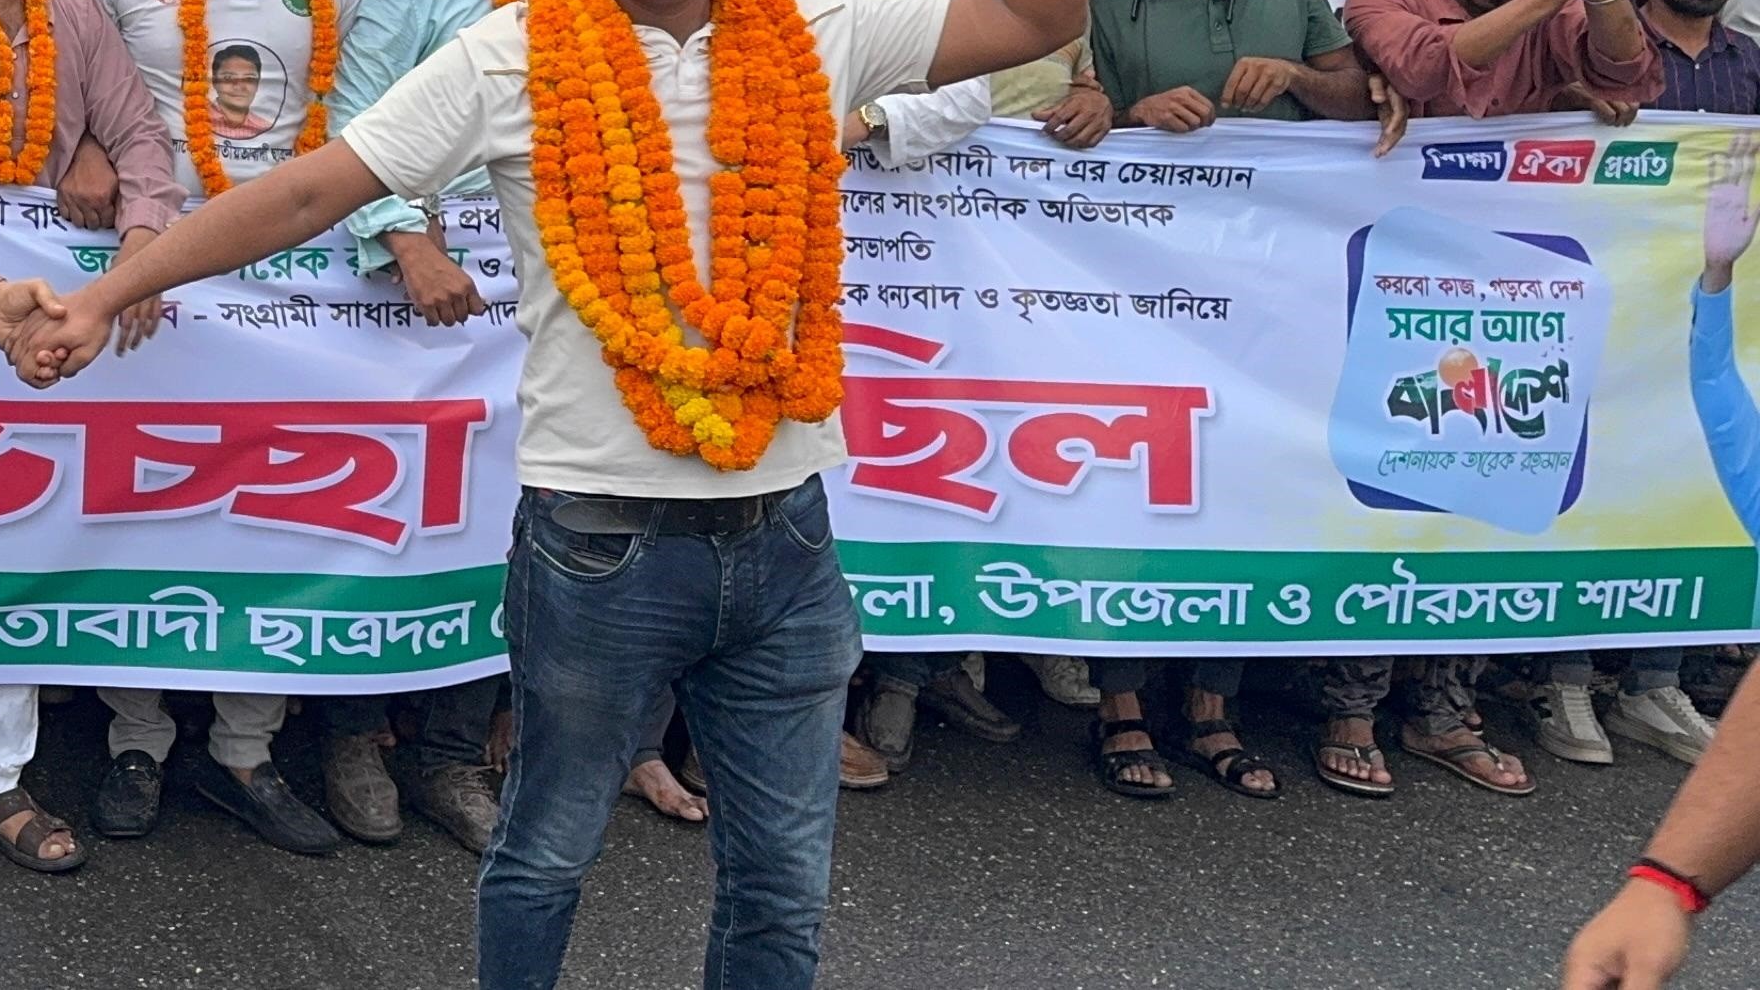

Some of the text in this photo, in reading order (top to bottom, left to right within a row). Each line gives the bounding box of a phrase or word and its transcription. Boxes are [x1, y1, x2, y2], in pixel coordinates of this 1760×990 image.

[1006, 155, 1056, 181] দল
[1063, 160, 1108, 185] এর
[1117, 160, 1258, 191] চেয়ারম্যান
[1426, 148, 1502, 173] শিক্ষা
[1517, 149, 1586, 179] ঐক্য
[1603, 149, 1669, 179] প্রগতি
[890, 184, 1029, 221] সাংগঠনিক
[1038, 193, 1177, 228] অভিভাবক
[239, 246, 329, 281] ারেক
[843, 231, 936, 262] সভাপতি
[877, 283, 1232, 324] ধন্যবাদ ও কৃতজ্ঞতা জানিয়ে
[1373, 274, 1430, 298] করবো
[1490, 278, 1545, 303] গড়বো
[1549, 278, 1585, 301] দেশ
[217, 295, 320, 329] সংগ্রামী
[1385, 307, 1566, 346] সবার আগে
[839, 322, 1208, 514] ছিল
[1378, 450, 1572, 477] দেশনায়ক তারেক রহমান
[245, 599, 476, 665] ছাত্রদল
[842, 572, 956, 626] লা,
[975, 562, 1254, 627] উপজেলা
[1267, 583, 1312, 626] ও
[1335, 557, 1564, 627] পৌরসভা
